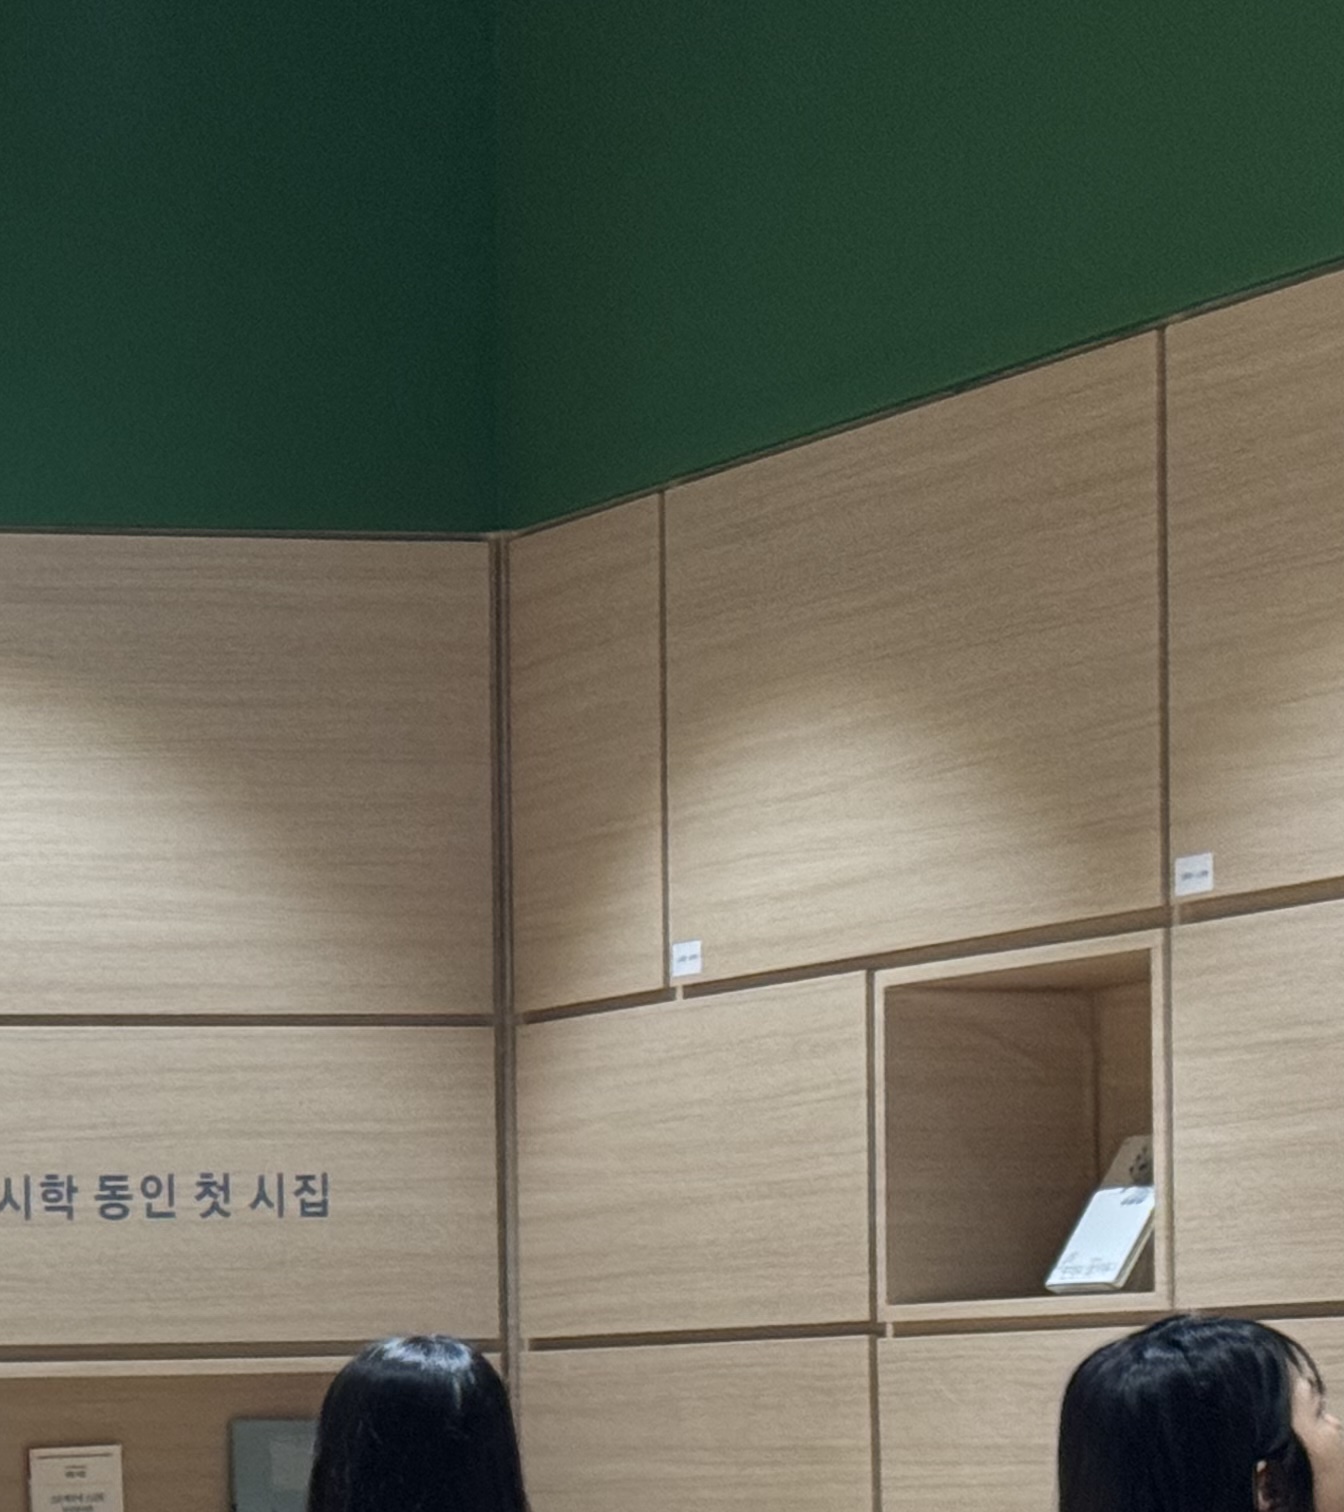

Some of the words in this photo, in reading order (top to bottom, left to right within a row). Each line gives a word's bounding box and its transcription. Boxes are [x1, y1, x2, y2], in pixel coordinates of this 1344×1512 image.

[93, 1173, 177, 1220] 동인
[193, 1171, 233, 1218] 첫
[249, 1171, 330, 1218] 시집
